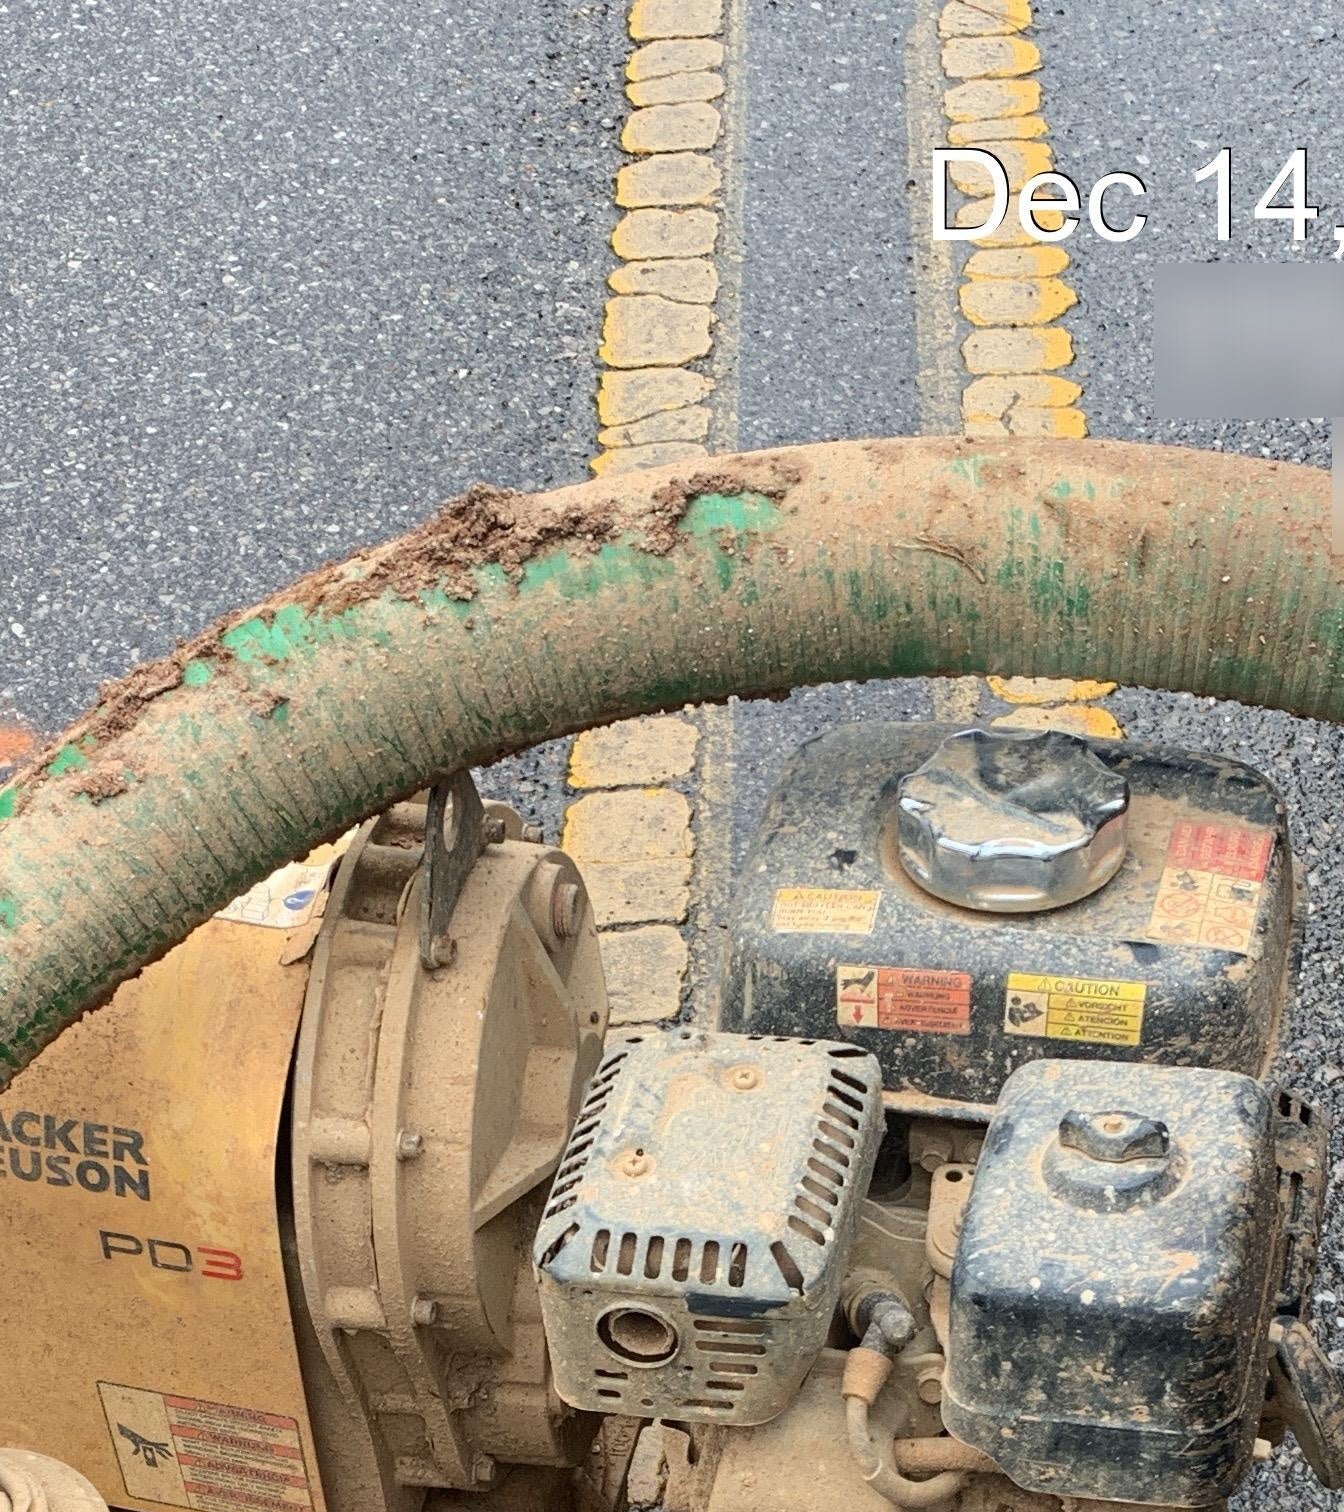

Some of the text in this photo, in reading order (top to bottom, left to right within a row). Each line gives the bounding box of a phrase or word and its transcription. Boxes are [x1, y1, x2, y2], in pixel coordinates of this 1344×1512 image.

[901, 973, 962, 989] WARNING
[1054, 980, 1121, 997] CAUTION
[99, 1229, 244, 1282] PD3
